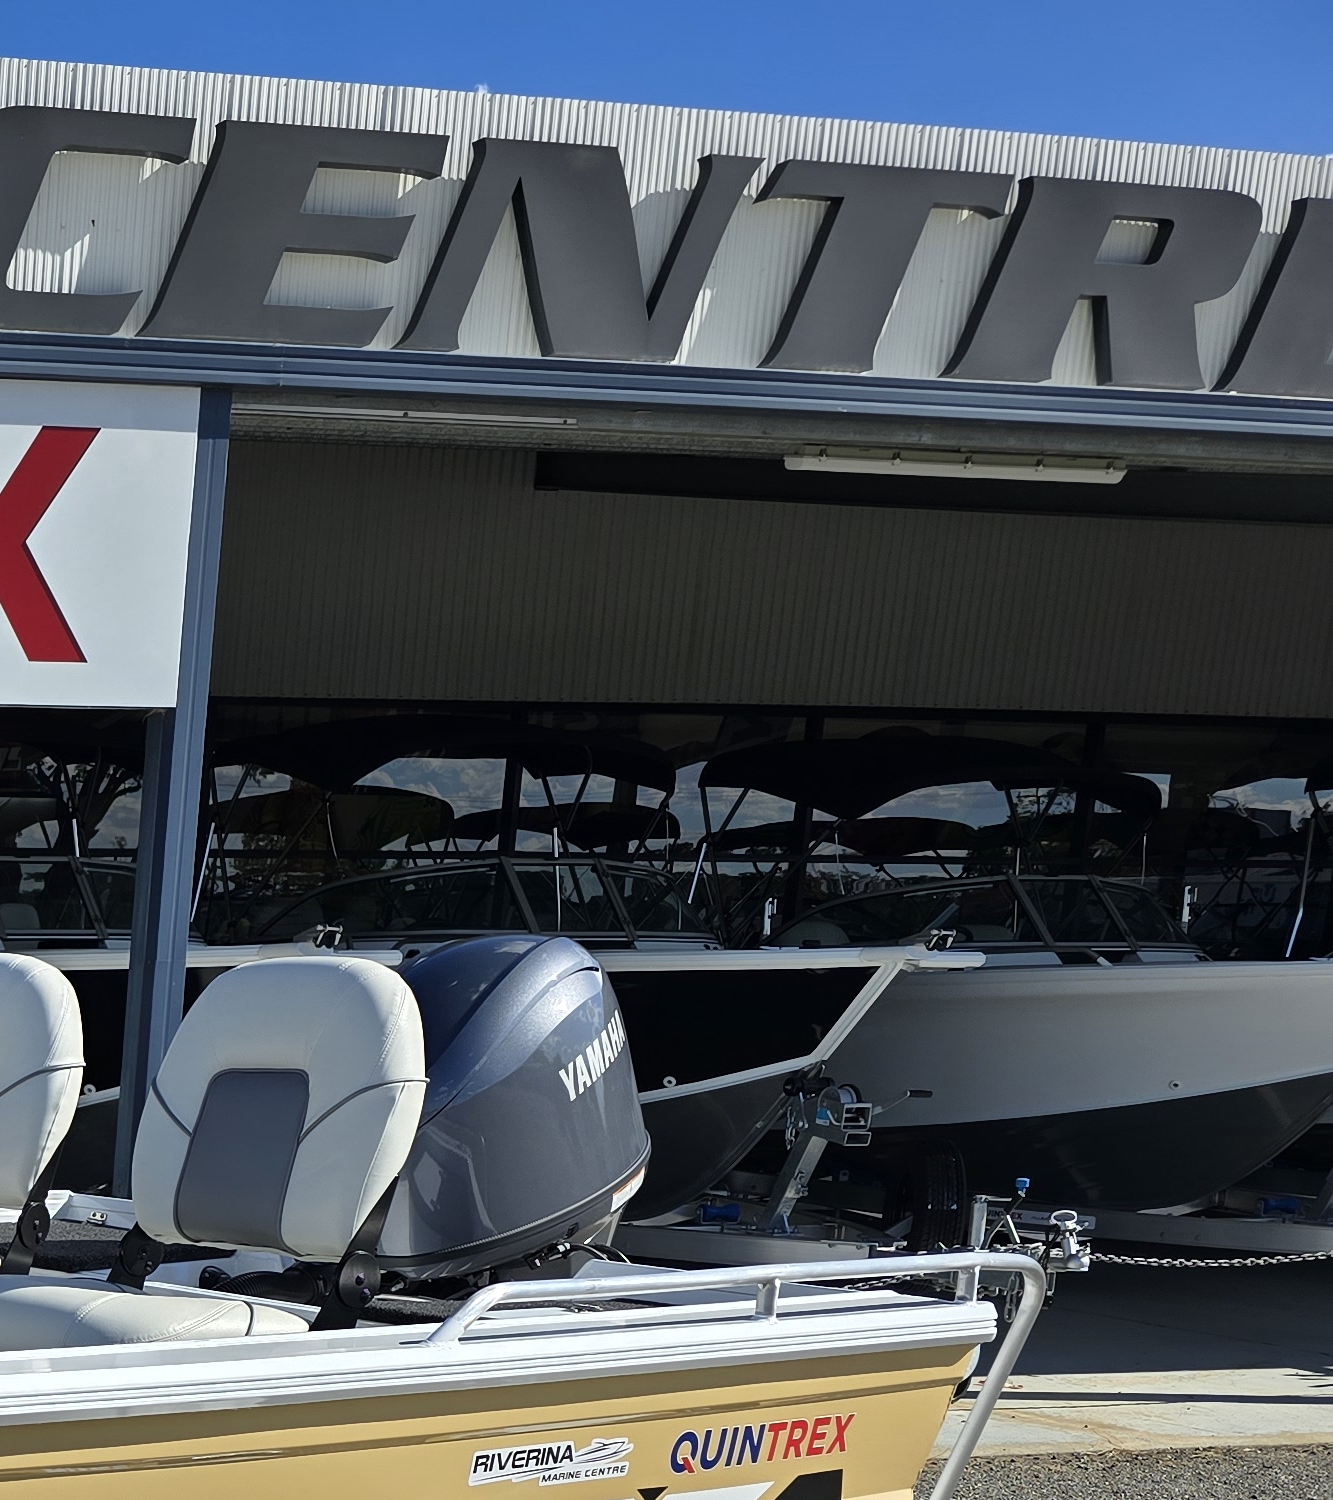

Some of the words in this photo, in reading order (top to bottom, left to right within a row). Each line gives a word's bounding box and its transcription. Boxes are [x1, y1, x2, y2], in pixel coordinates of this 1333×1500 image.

[558, 1009, 626, 1102] YAMAHA
[472, 1444, 574, 1474] RIVERINA
[670, 1413, 856, 1474] QUINTREX
[541, 1470, 582, 1483] MARINE
[584, 1464, 627, 1477] CENTRE
